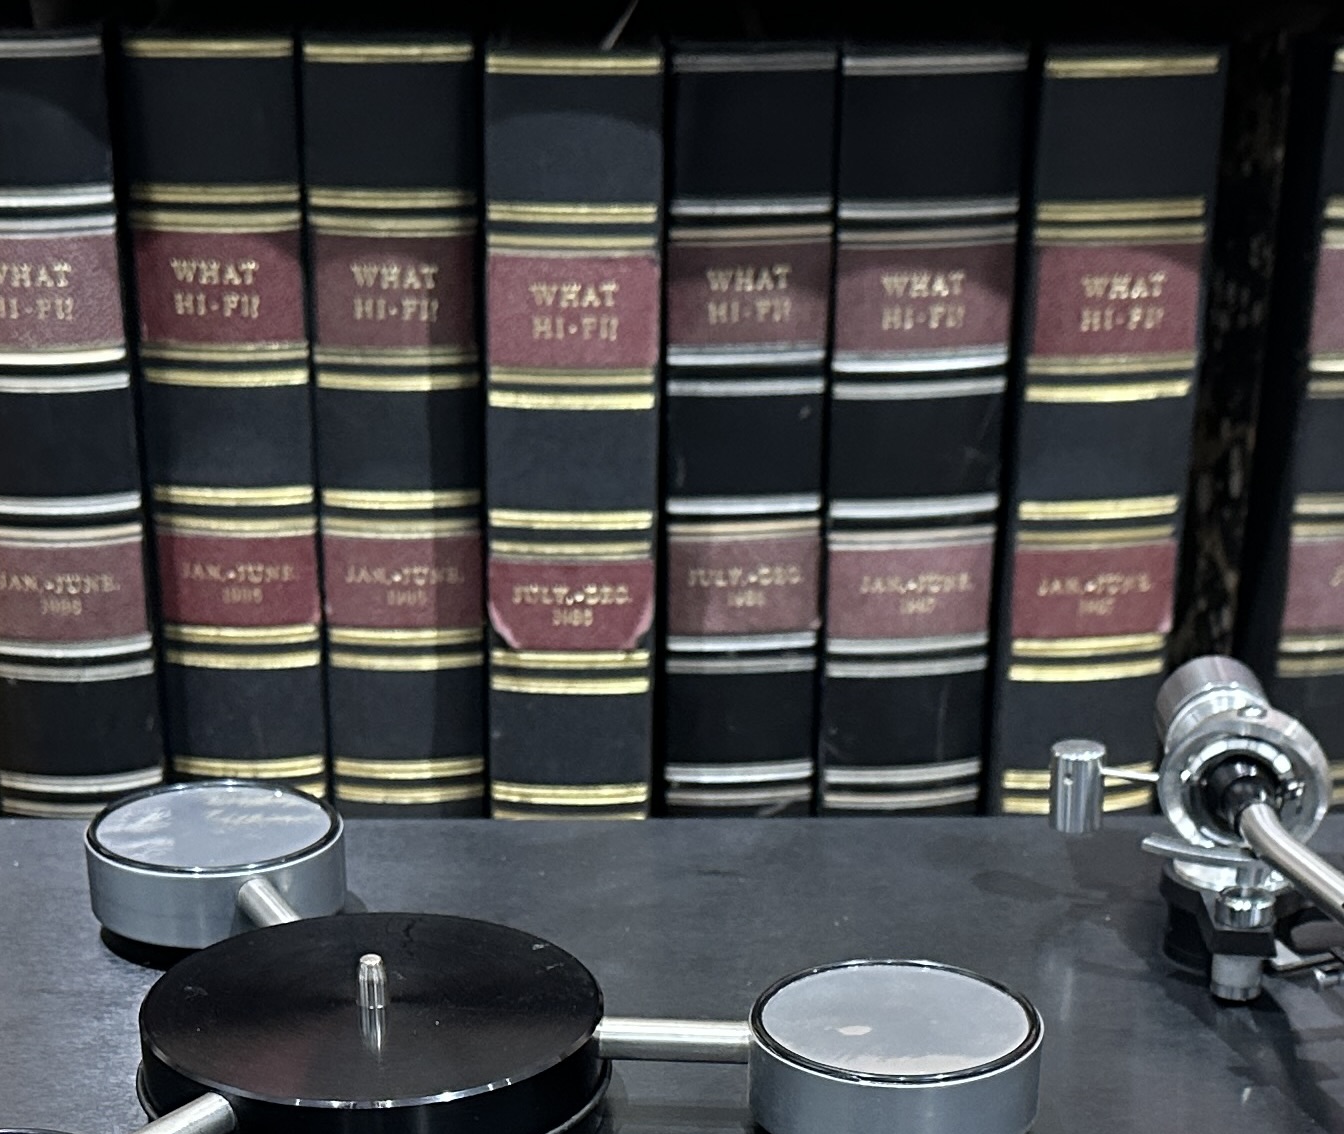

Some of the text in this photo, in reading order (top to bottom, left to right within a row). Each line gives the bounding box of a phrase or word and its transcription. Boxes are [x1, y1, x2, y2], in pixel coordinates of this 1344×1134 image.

[171, 257, 260, 285] WHAT
[350, 263, 439, 289] WHAT
[706, 265, 792, 292] WHAT
[881, 270, 965, 298] WHAT
[529, 281, 620, 308] WHAT
[1081, 272, 1167, 299] WHAT
